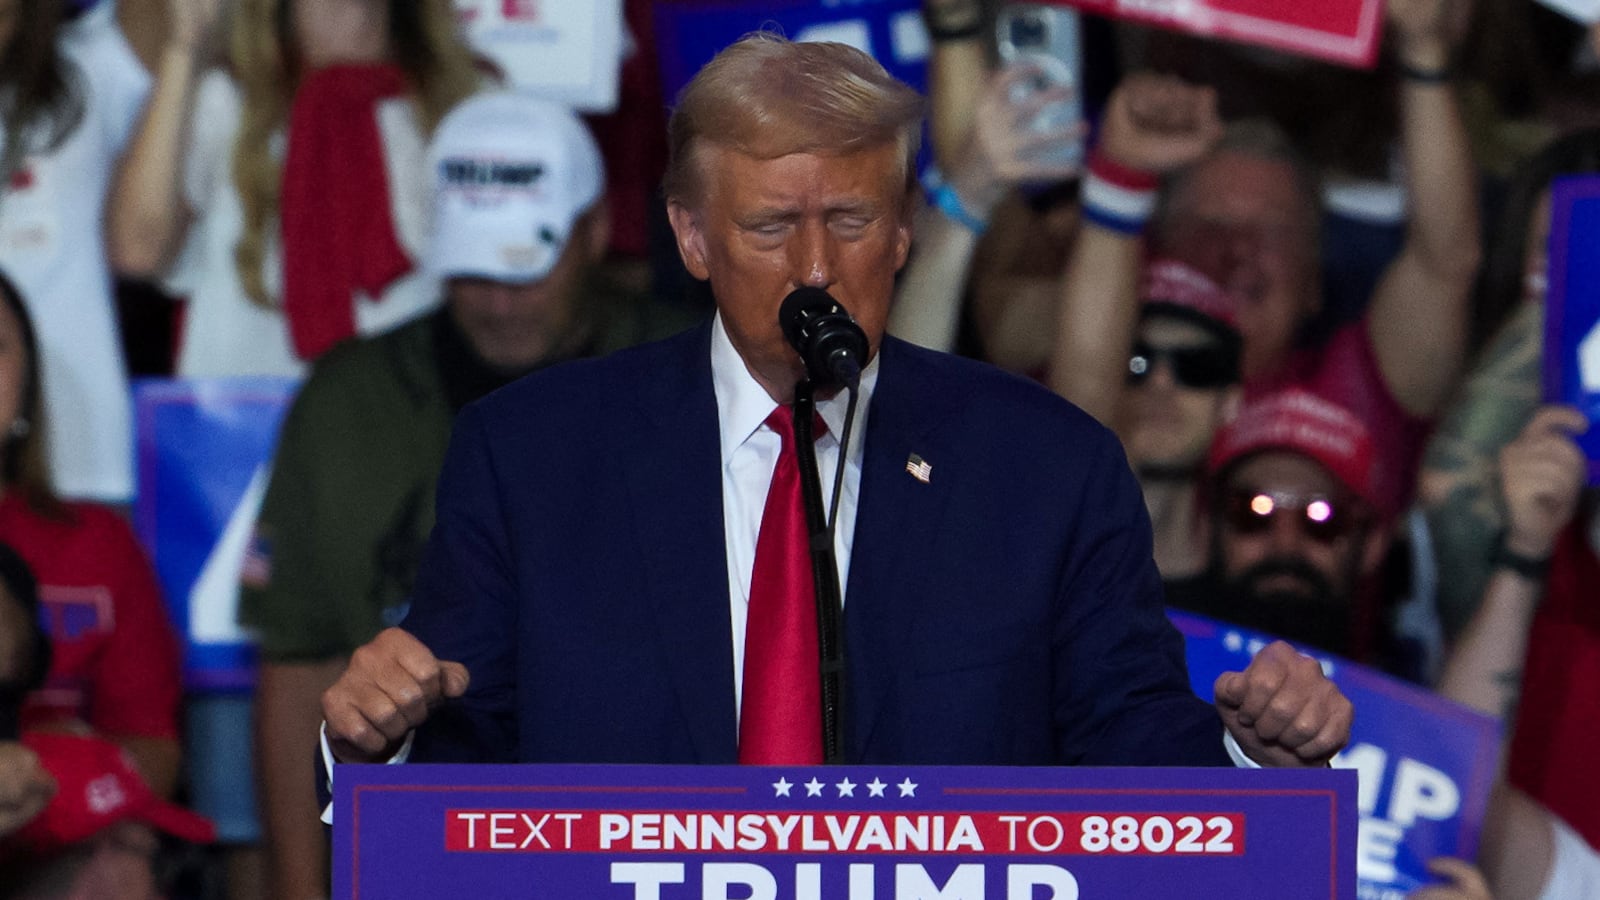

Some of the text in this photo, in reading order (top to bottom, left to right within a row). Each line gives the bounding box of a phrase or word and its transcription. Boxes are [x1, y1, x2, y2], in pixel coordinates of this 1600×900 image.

[457, 813, 1234, 853] TEXT PENNSYLVANIA TO 88022
